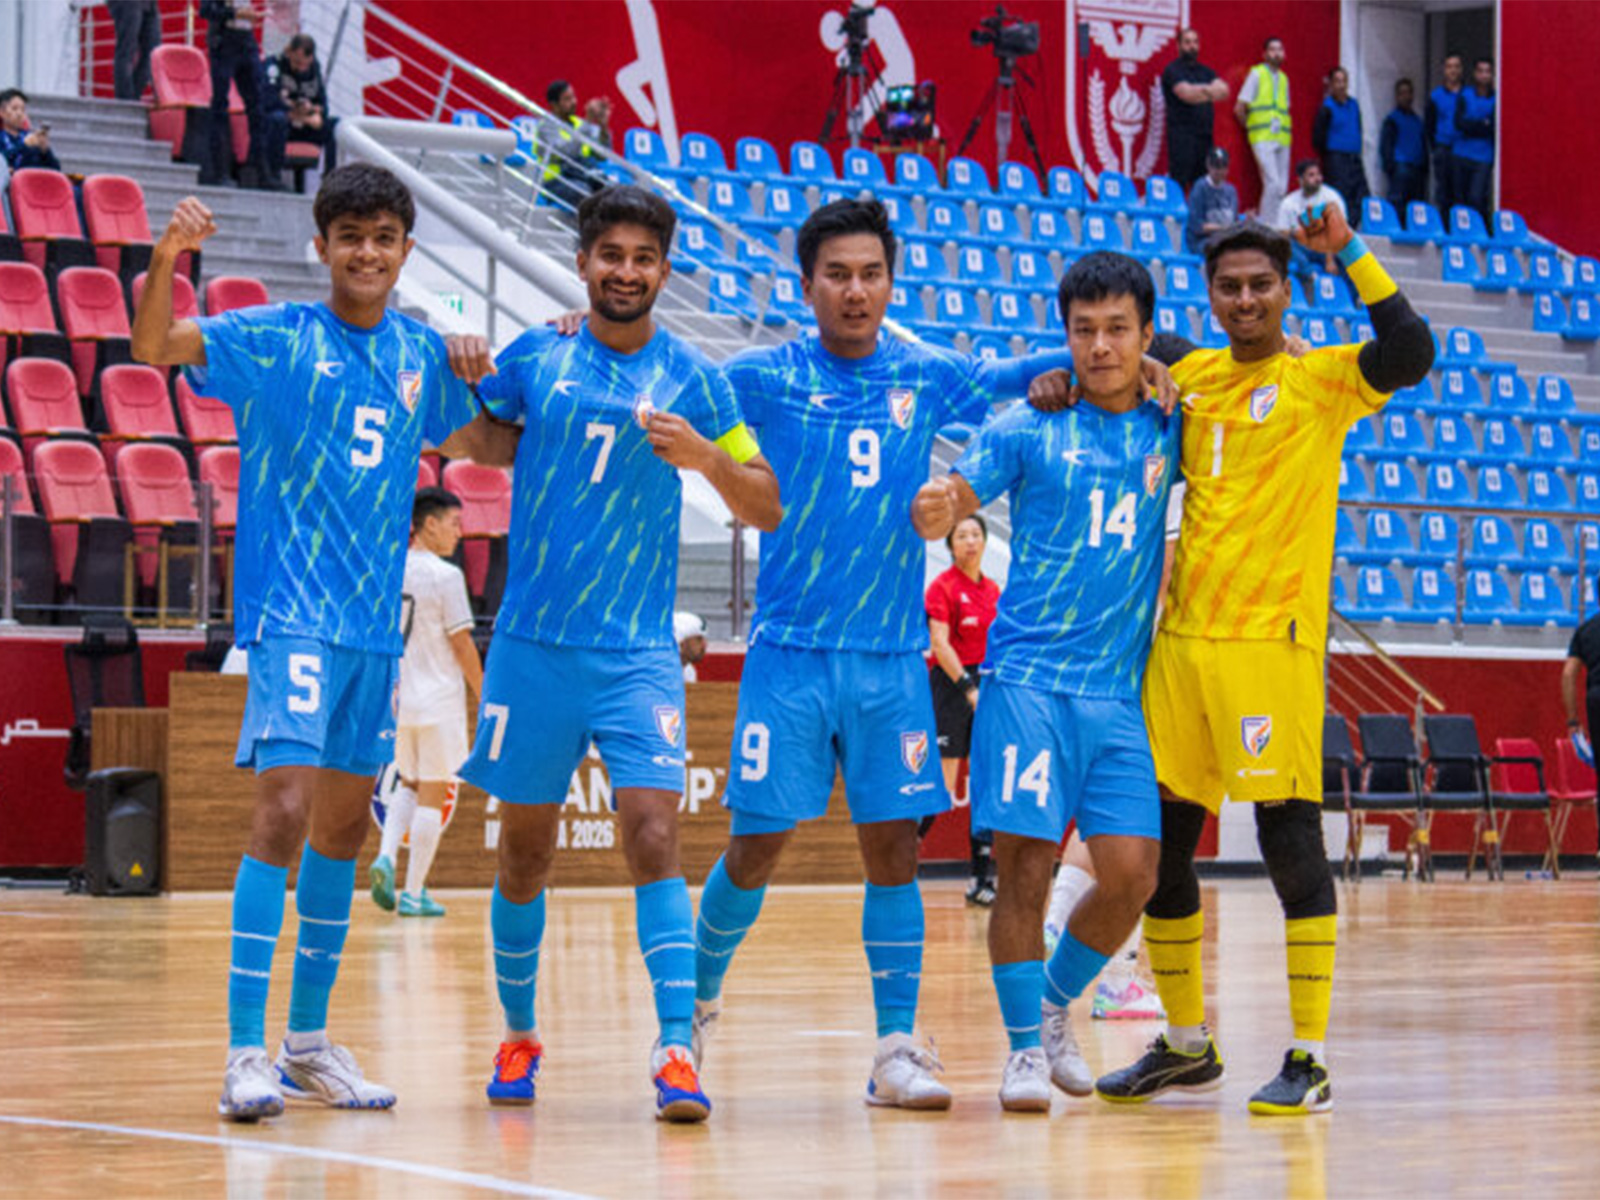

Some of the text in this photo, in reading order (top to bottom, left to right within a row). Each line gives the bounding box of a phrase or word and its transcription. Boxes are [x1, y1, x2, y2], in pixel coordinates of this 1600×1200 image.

[351, 405, 386, 469] 5
[586, 422, 616, 484] 7
[849, 428, 880, 487] 9
[1212, 422, 1223, 477] 1
[1088, 489, 1137, 550] 14
[288, 653, 321, 714] 5
[484, 703, 509, 762] 7
[741, 722, 770, 781] 9
[1002, 744, 1051, 807] 14
[571, 820, 615, 849] 2026
